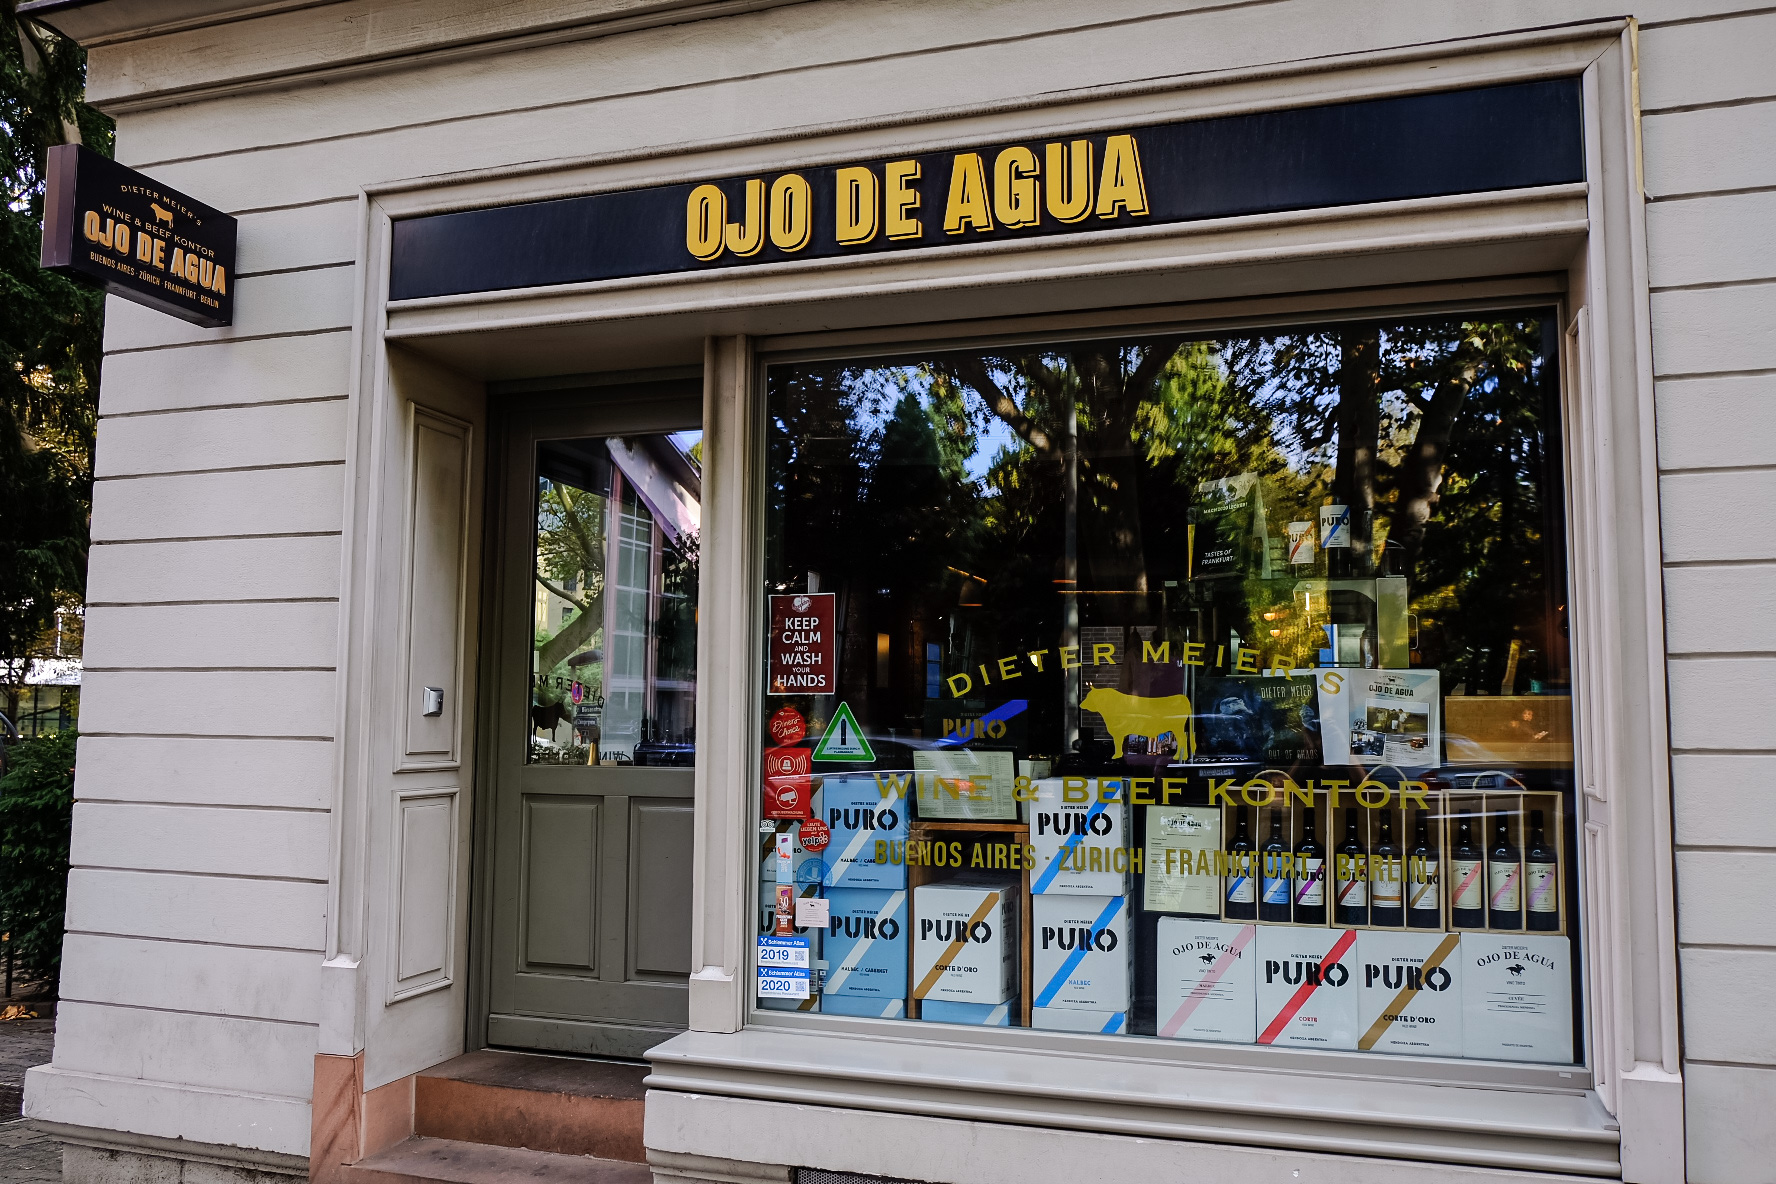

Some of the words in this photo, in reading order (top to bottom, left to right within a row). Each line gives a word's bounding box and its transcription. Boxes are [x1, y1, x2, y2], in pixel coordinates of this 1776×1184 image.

[121, 185, 159, 199] DIETER
[163, 196, 202, 226] MEIER'S
[685, 173, 811, 261] OJO
[835, 160, 922, 246] DE
[943, 134, 1150, 236] AGUA
[102, 203, 131, 223] WINE
[134, 217, 142, 227] &
[145, 222, 172, 238] BEEF
[174, 235, 215, 258] KONTOR
[84, 210, 131, 257] OJO
[136, 231, 166, 271] DE
[170, 247, 226, 296] AGUA
[90, 251, 116, 269] BUENOS
[116, 262, 135, 276] AIRES
[139, 270, 160, 286] ZÜRICH
[164, 280, 197, 300] FRANKFURT
[200, 294, 219, 309] BERLIN
[1321, 516, 1349, 526] PURO
[785, 617, 819, 630] KEEP
[782, 631, 821, 644] CALM
[781, 652, 822, 665] WASH
[946, 643, 1117, 698] DIETER
[1142, 640, 1346, 697] MEIER'S
[777, 674, 826, 687] HANDS
[1260, 686, 1286, 699] DIETER
[1290, 684, 1312, 698] MEIER
[1368, 685, 1383, 693] OJO
[1384, 686, 1393, 695] DE
[1394, 688, 1414, 697] AGUA
[942, 718, 1007, 739] PURO
[873, 773, 993, 801] WINE
[1011, 775, 1039, 803] &
[1062, 776, 1188, 805] BEEF
[1208, 778, 1431, 810] KONTOR
[829, 808, 898, 831] PURO
[1037, 812, 1113, 836] PURO
[801, 836, 820, 847] yelp
[874, 839, 962, 868] BUENOS
[970, 843, 1036, 870] AIRES
[1058, 841, 1143, 874] ZÜRICH
[1165, 849, 1311, 879] FRANKFURT
[1336, 853, 1428, 882] BERLIN
[830, 915, 900, 941] PURO
[920, 918, 992, 944] PURO
[1041, 926, 1118, 952] PURO
[760, 949, 790, 961] 2019
[1172, 942, 1194, 956] OJO
[1196, 941, 1211, 950] DE
[1213, 942, 1242, 960] AGUA
[1476, 952, 1500, 967] OJO
[1504, 951, 1520, 960] DE
[1522, 953, 1555, 970] AGUA
[935, 964, 956, 972] CORTE
[956, 965, 978, 973] D'ORO
[1265, 960, 1350, 987] PURO
[1365, 963, 1452, 992] PURO
[761, 979, 791, 991] 2020
[1383, 1014, 1408, 1023] CORTE
[1410, 1016, 1436, 1024] D'ORO
